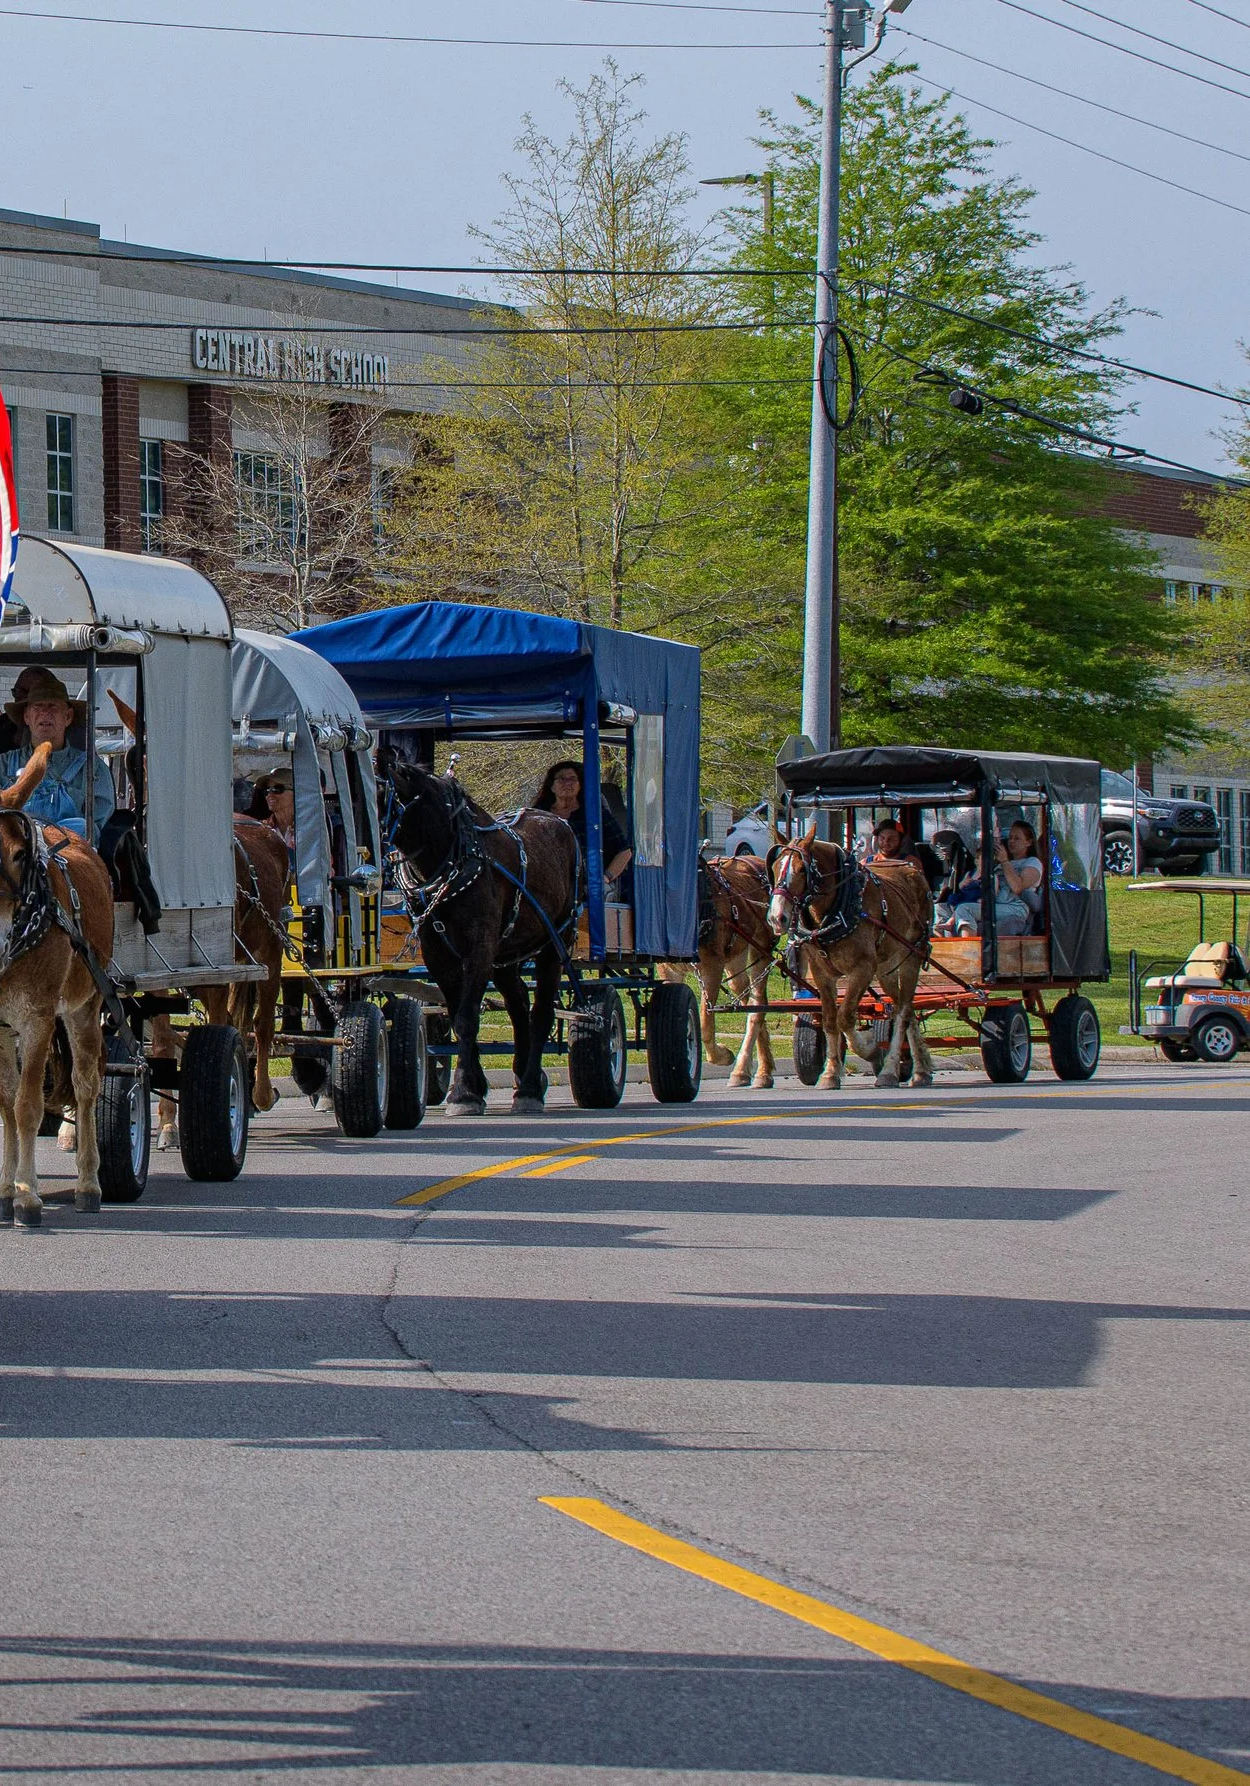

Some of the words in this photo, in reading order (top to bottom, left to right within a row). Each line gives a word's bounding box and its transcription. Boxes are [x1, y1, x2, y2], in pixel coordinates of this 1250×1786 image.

[193, 328, 279, 379] CENTRAL
[283, 340, 326, 382] HIGH
[330, 348, 391, 394] SCHOOL
